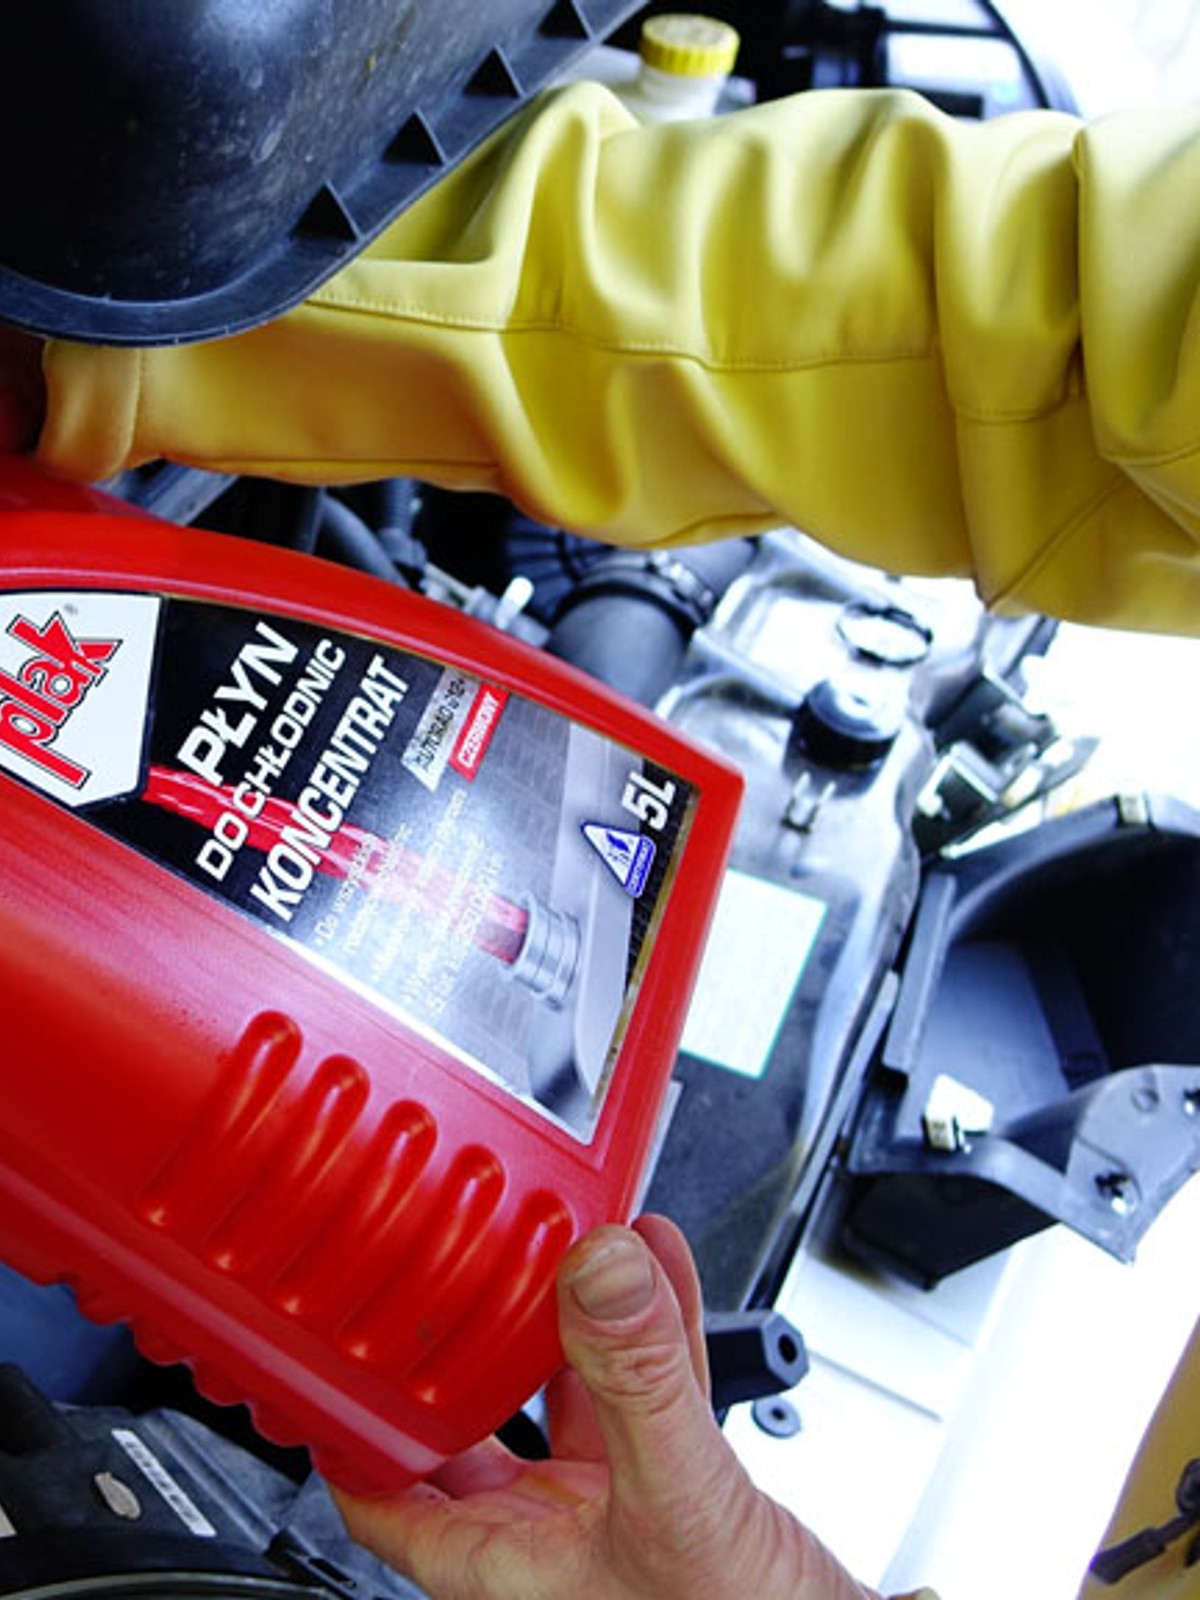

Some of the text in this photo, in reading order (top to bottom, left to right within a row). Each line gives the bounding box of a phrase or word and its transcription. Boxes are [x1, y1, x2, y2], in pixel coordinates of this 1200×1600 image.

[177, 621, 299, 786] PŁYN
[195, 638, 346, 882] DO CHŁODNIC
[250, 653, 410, 923] KONCENTRAT
[621, 770, 676, 832] 5L
